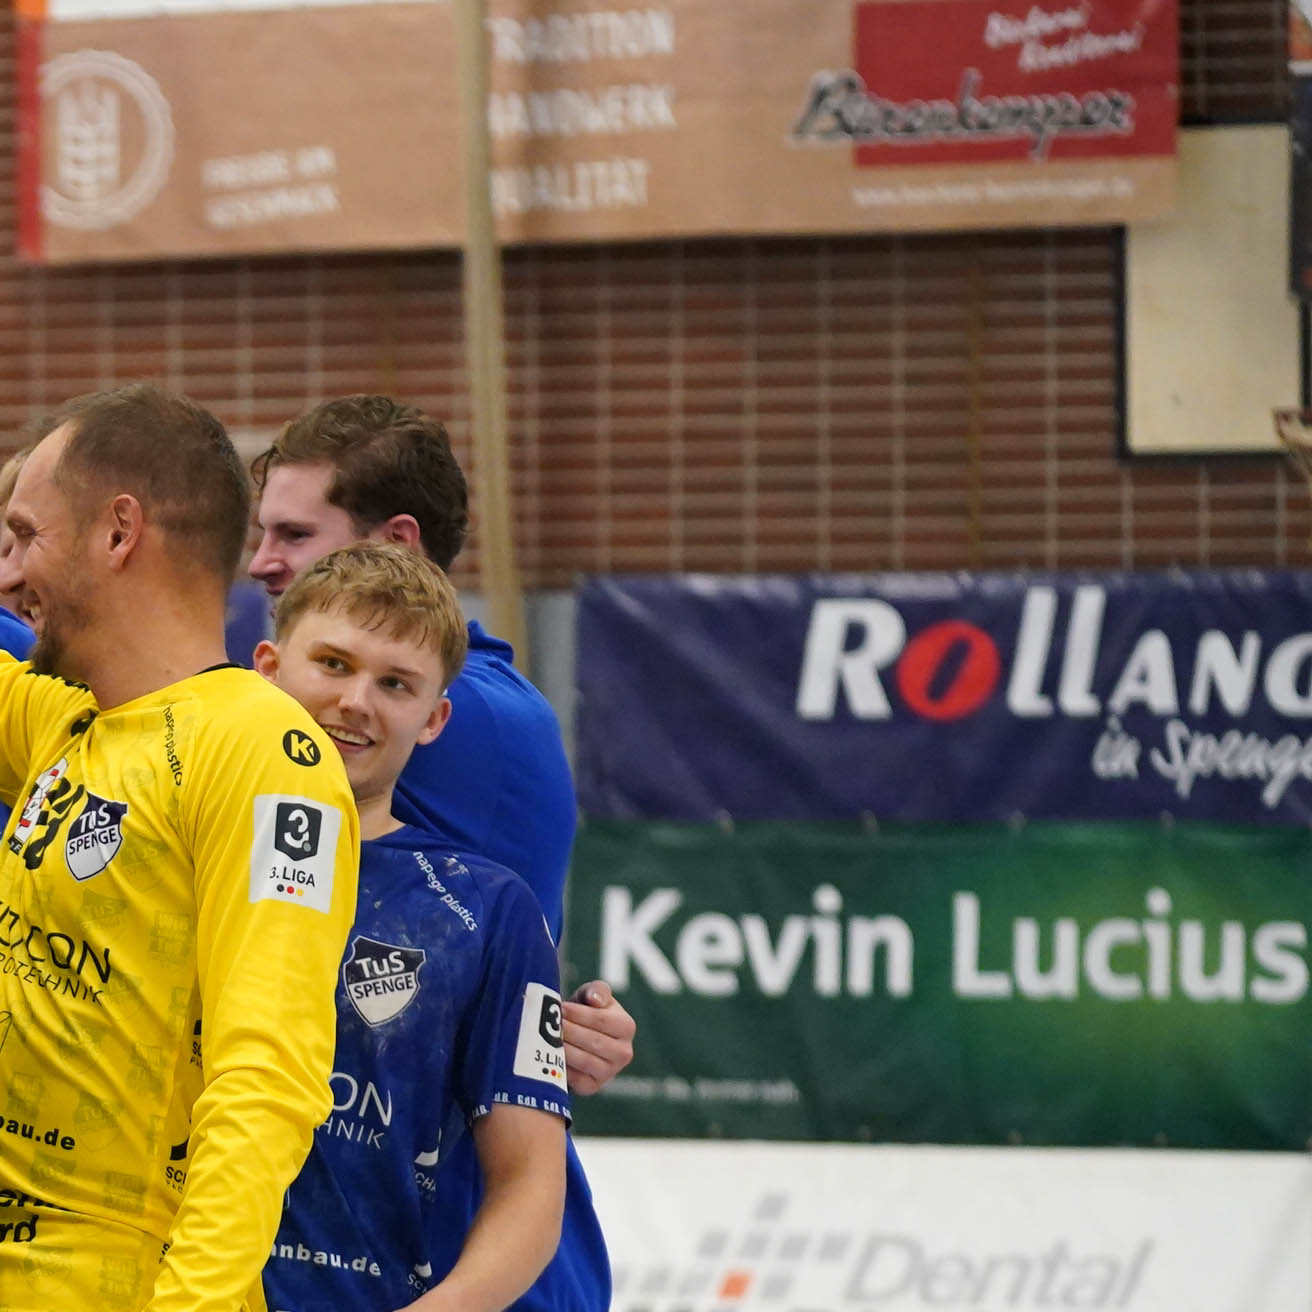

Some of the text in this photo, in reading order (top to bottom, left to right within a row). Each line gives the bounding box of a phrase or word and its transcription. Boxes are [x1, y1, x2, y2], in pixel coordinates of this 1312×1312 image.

[69, 827, 118, 854] SPENGE
[283, 867, 316, 887] LIGA
[439, 892, 478, 932] plastics
[599, 884, 1308, 1001] Kevin Lucius
[355, 949, 407, 978] TuS
[353, 974, 415, 1001] SPENGE
[845, 1233, 1156, 1310] Dental
